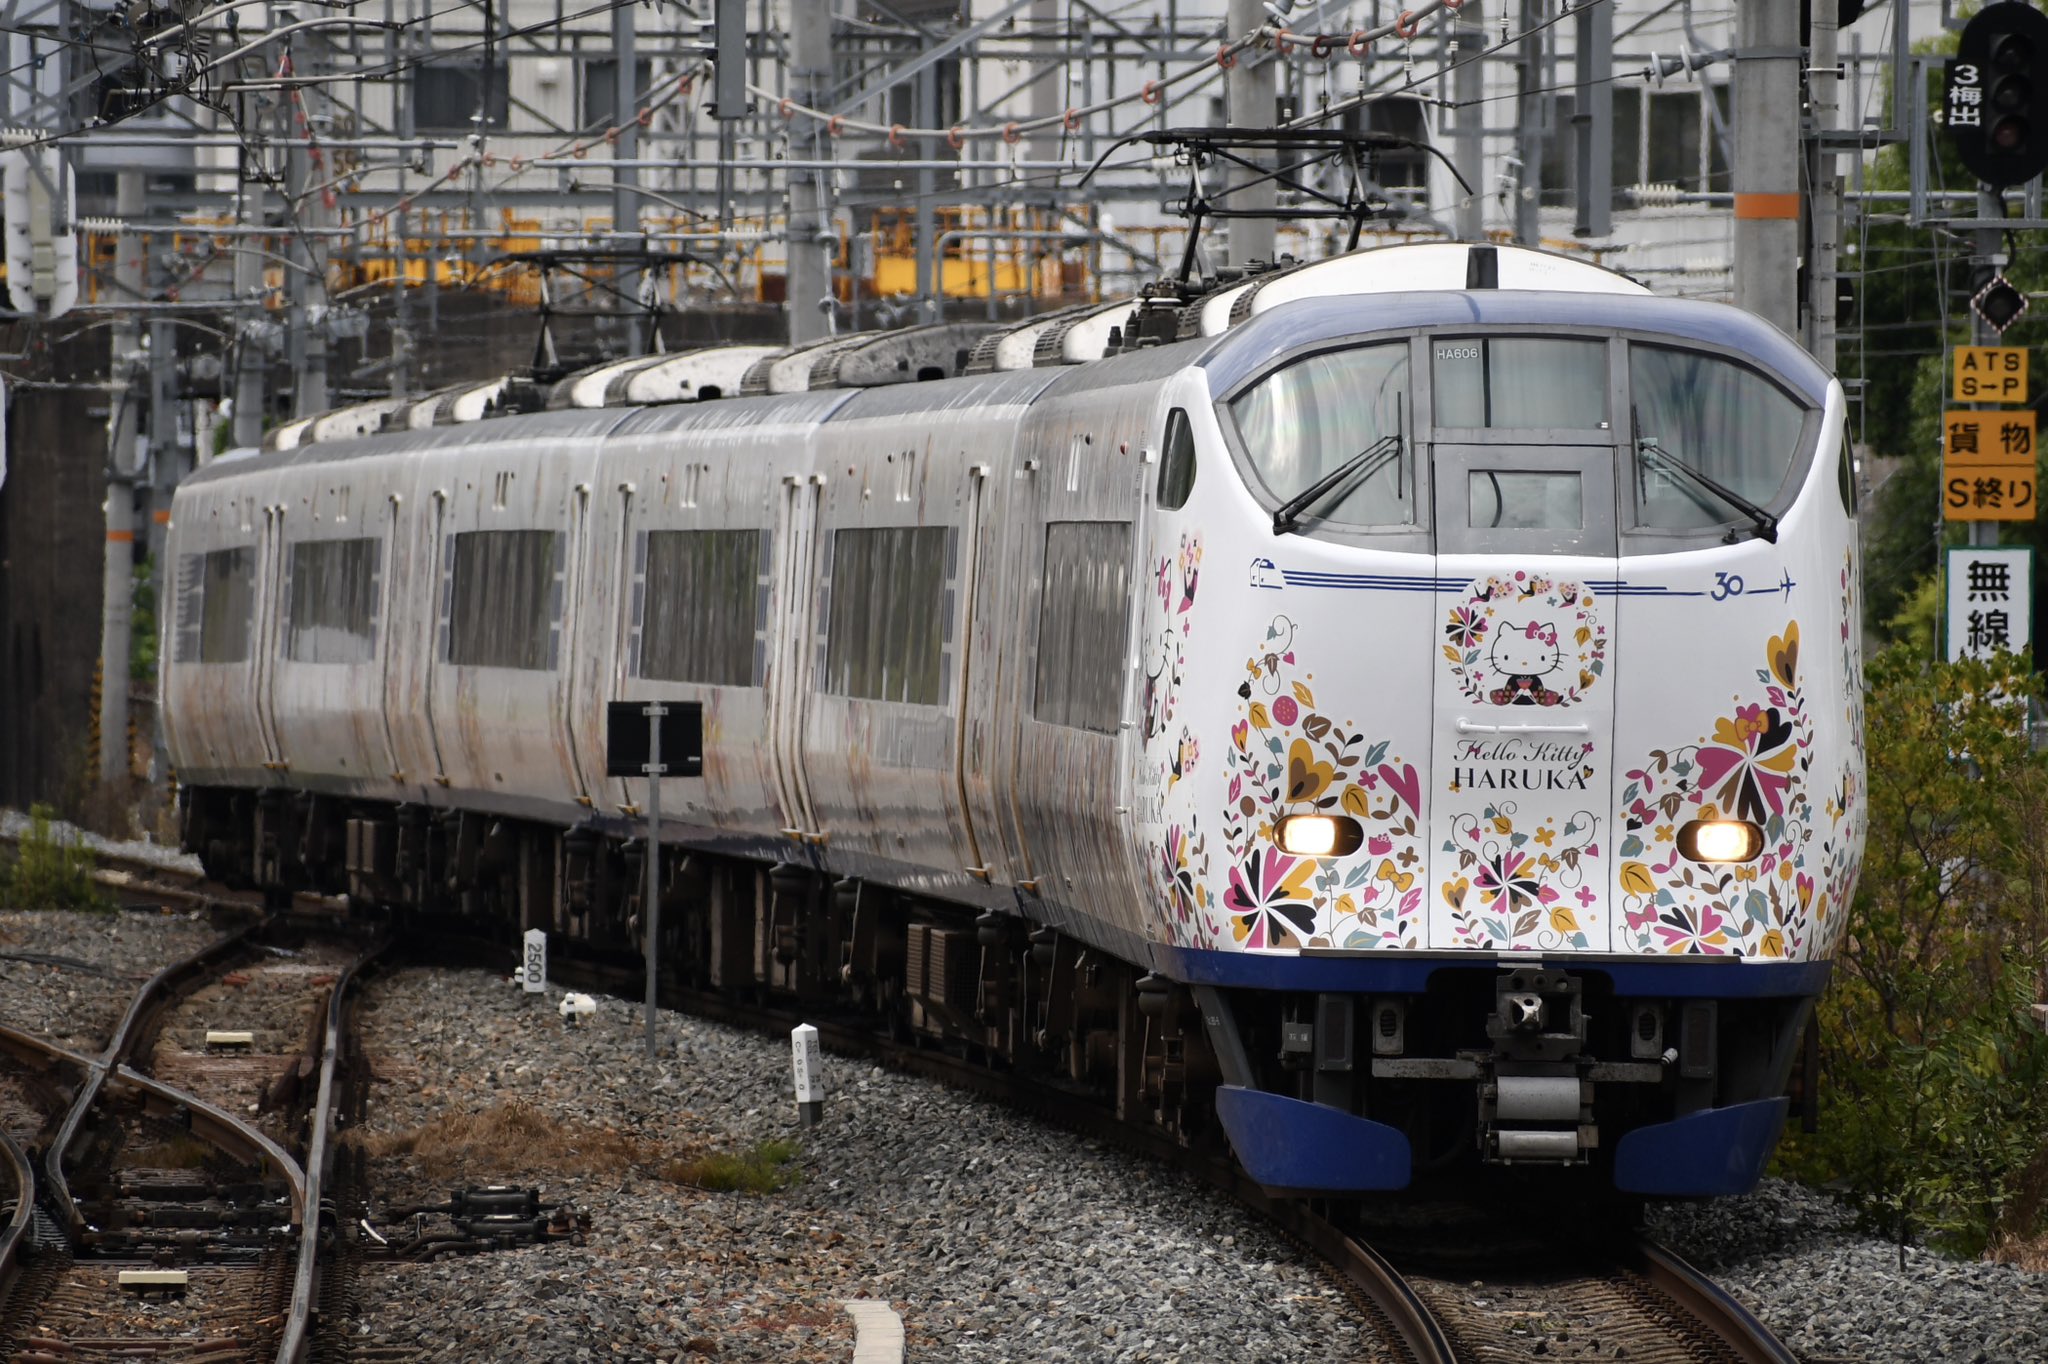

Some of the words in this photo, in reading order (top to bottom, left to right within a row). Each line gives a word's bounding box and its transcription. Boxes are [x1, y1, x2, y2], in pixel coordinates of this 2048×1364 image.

[1436, 347, 1478, 360] HA606
[1962, 351, 2020, 372] ATS
[1948, 477, 2033, 509] S終り
[1710, 571, 1744, 602] 30
[1966, 560, 2011, 653] 無線
[1453, 738, 1523, 762] Hello
[1523, 741, 1589, 771] Kitty
[1454, 767, 1588, 791] HARUKA
[527, 943, 543, 983] 2500
